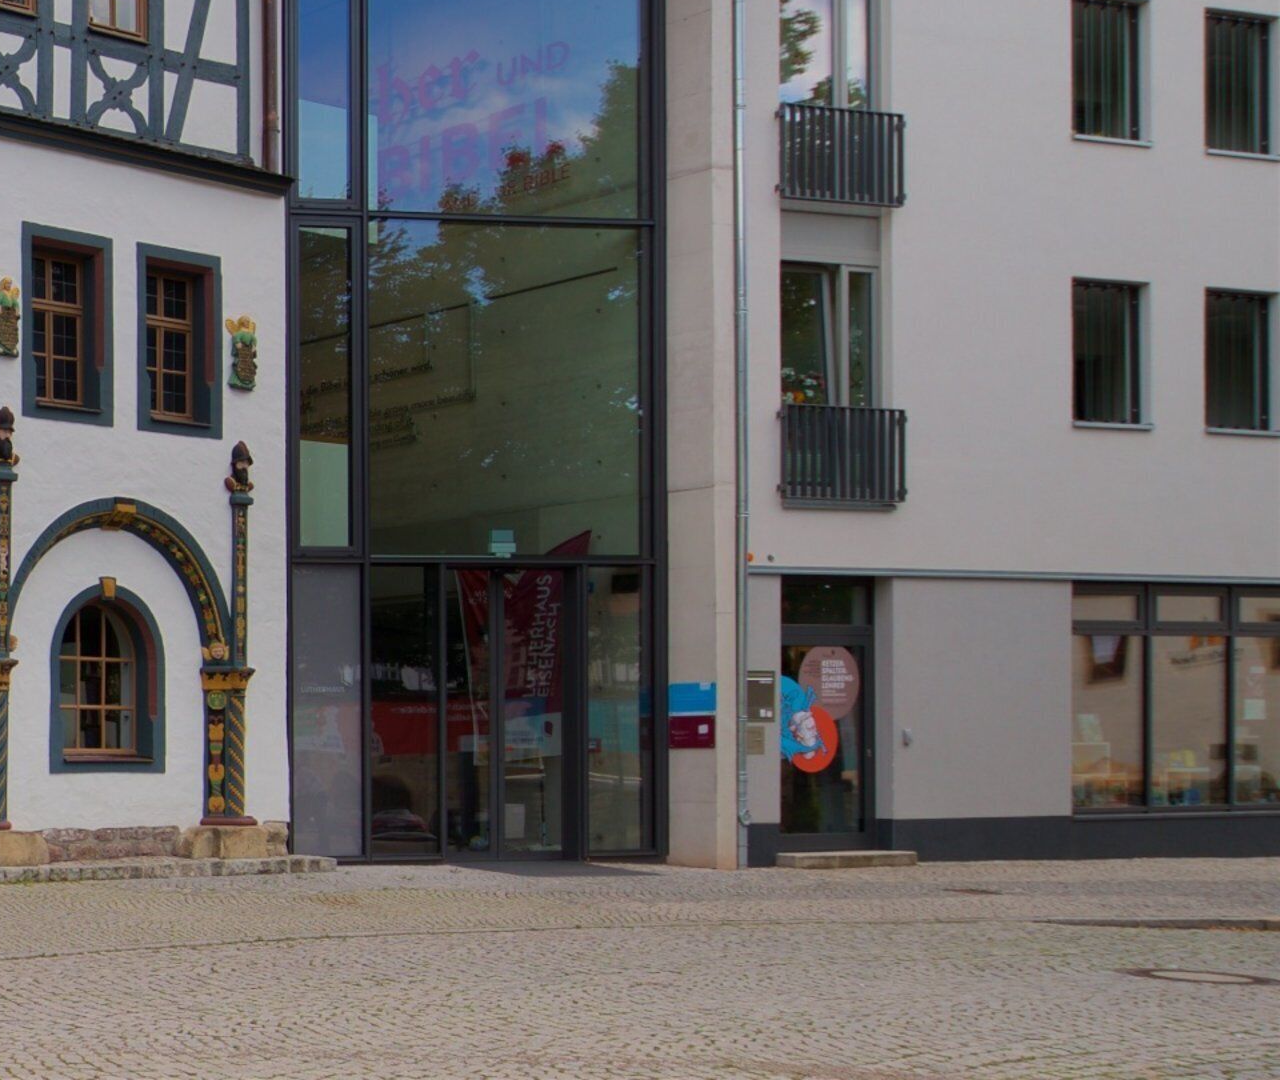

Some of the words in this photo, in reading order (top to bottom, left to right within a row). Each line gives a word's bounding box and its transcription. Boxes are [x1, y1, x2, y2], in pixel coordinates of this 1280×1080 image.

[496, 40, 571, 87] UND
[523, 163, 571, 192] BIBLE
[522, 573, 554, 698] LUTHERHAUS
[536, 602, 561, 698] EISENACH
